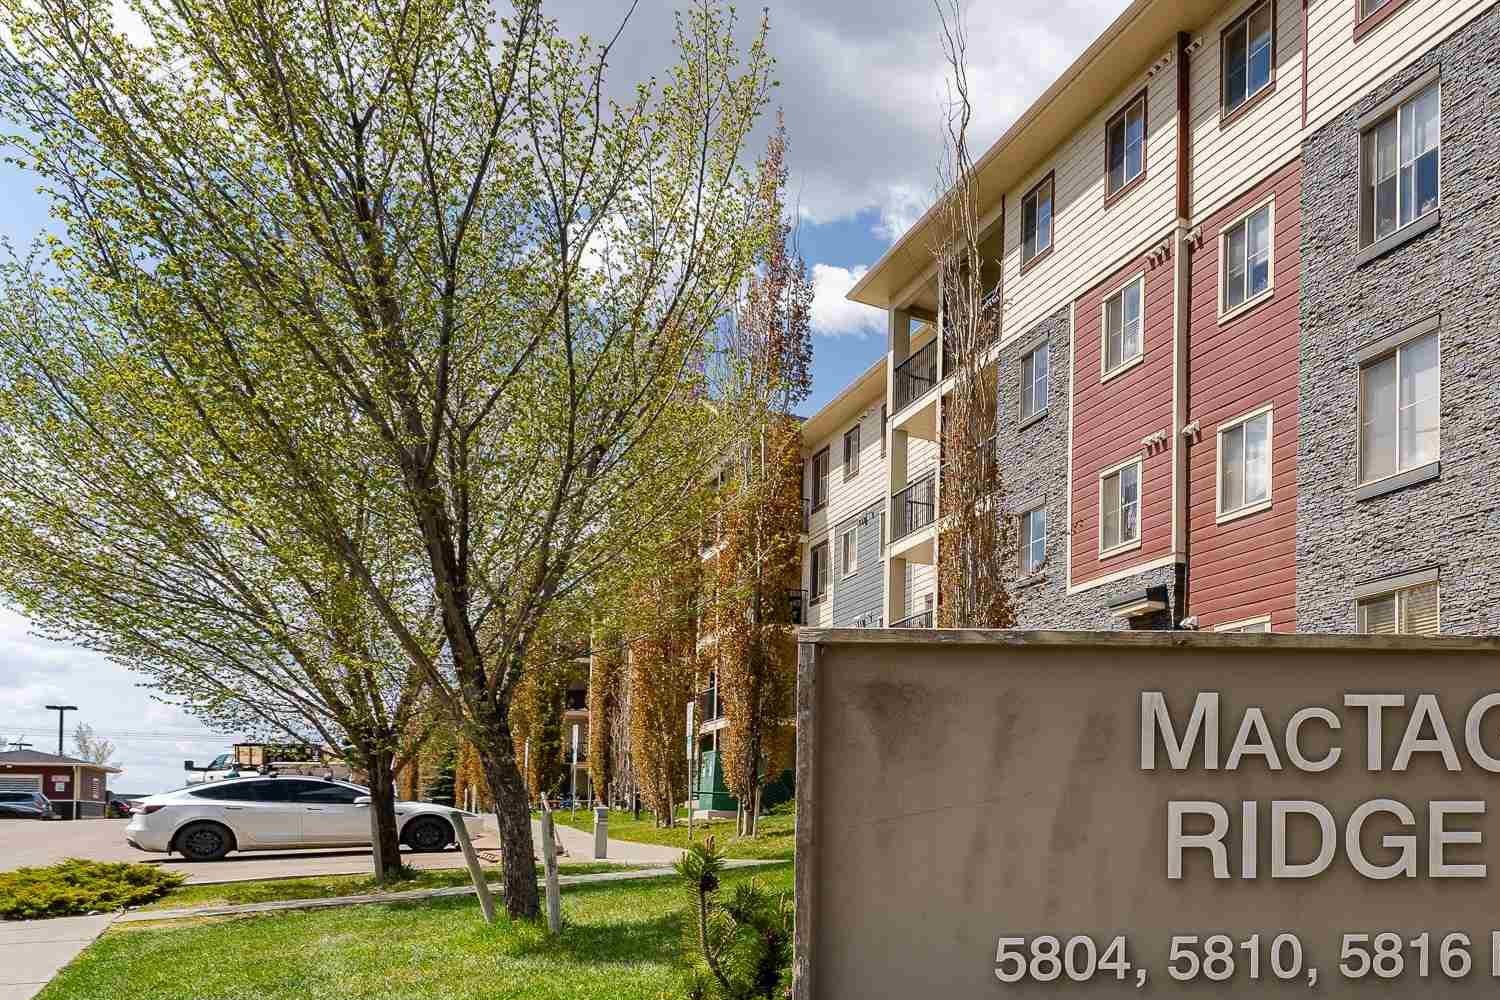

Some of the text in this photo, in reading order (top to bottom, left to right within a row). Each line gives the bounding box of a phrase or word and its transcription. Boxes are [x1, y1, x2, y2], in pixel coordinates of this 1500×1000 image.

[1166, 799, 1488, 880] RIDGE
[993, 934, 1148, 989] 5804,
[1166, 932, 1319, 988] 5810,
[1338, 931, 1473, 979] 5816
